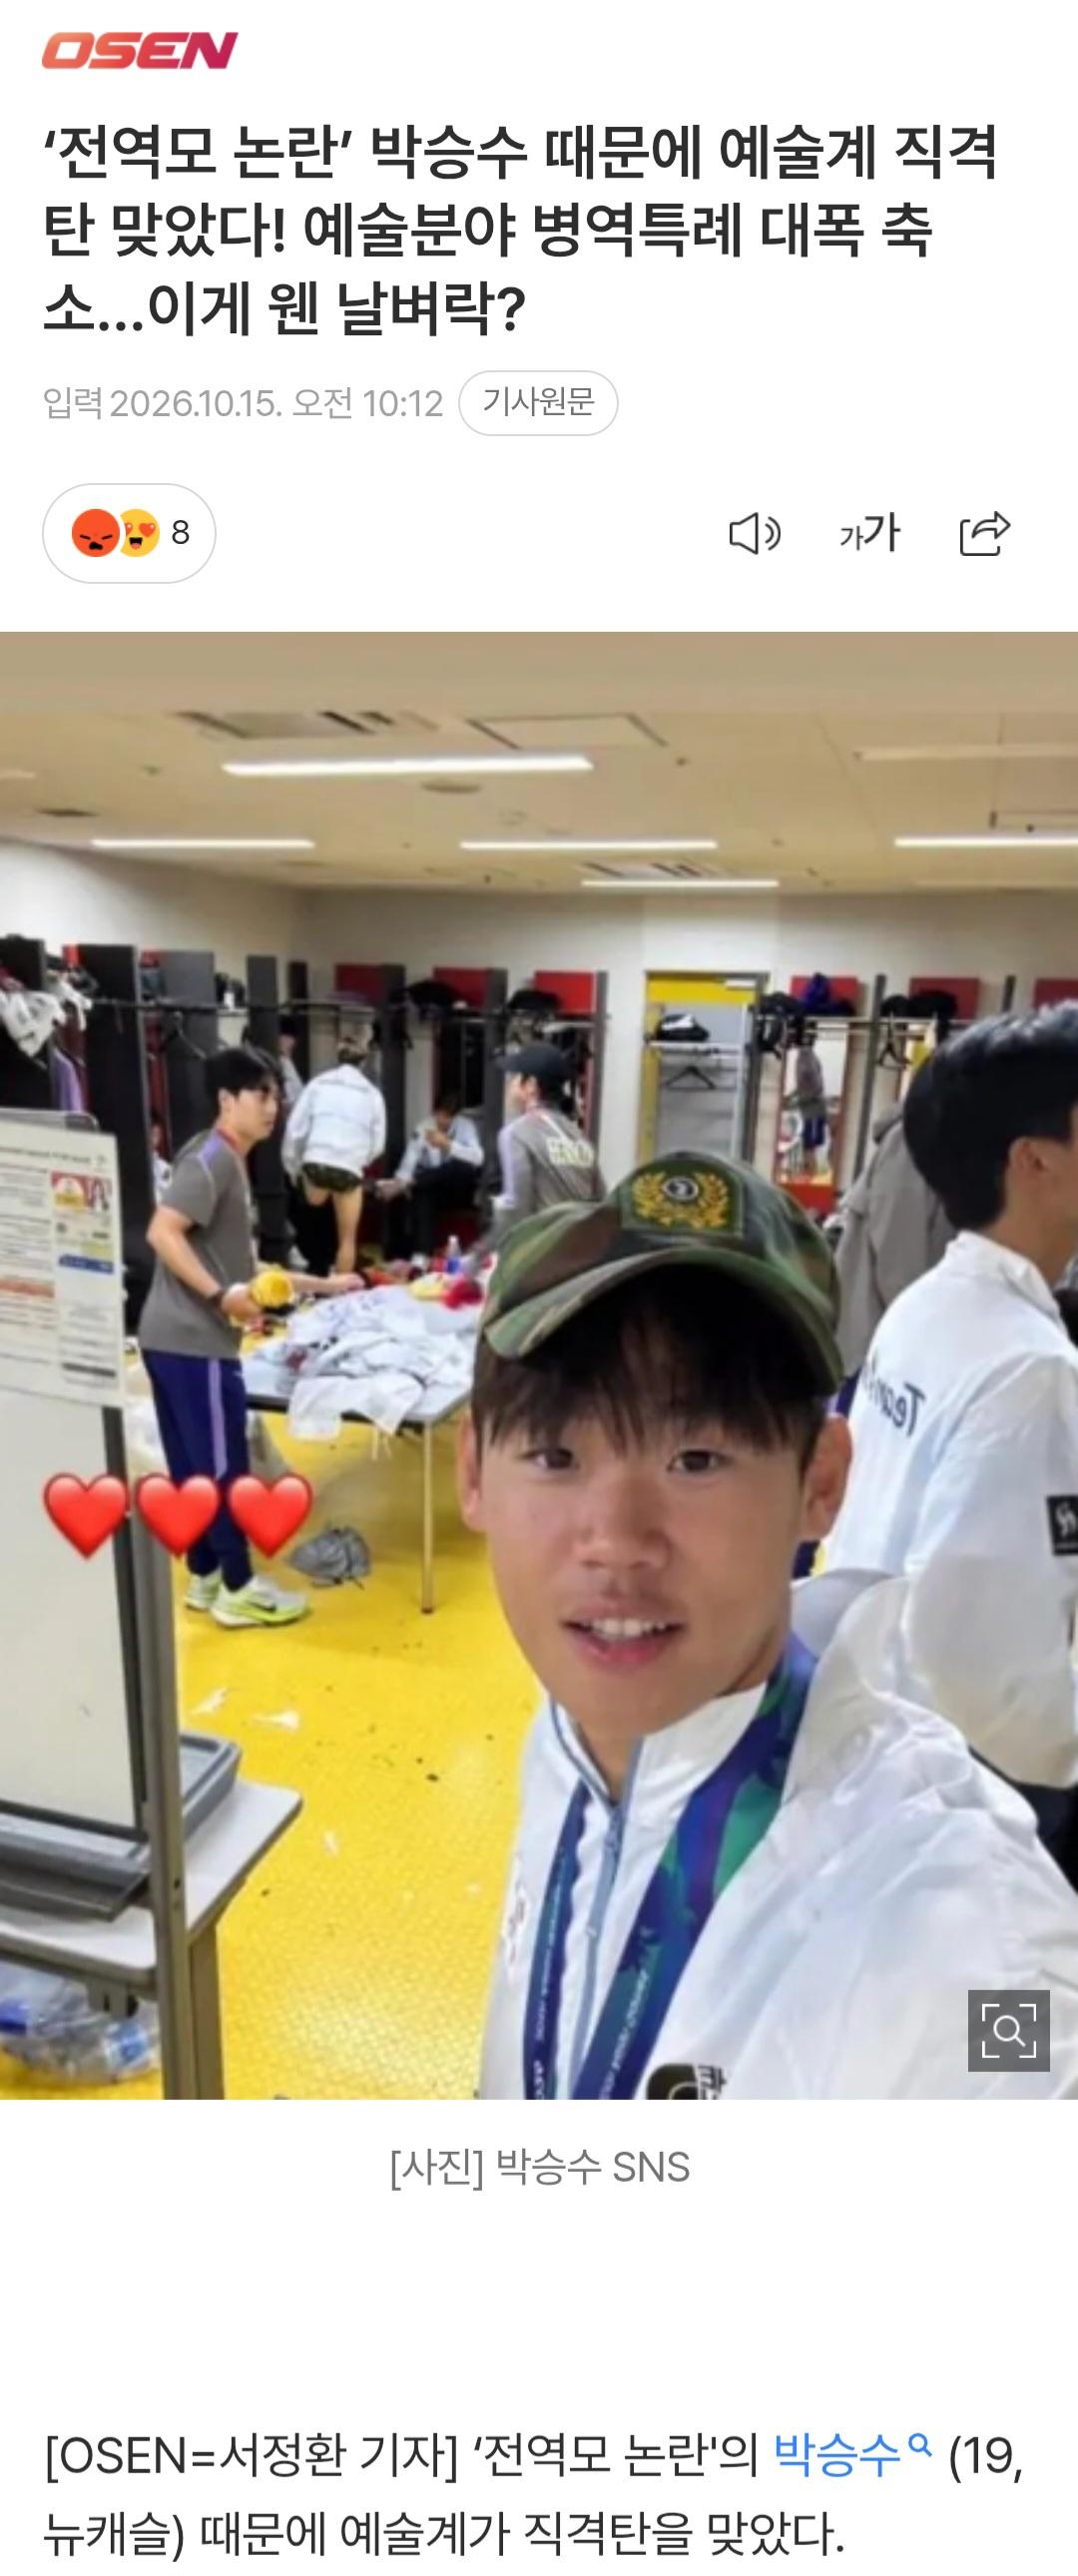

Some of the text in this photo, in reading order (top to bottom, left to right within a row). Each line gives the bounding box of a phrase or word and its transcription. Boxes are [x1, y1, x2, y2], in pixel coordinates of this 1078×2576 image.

[42, 32, 239, 69] OSEN
[44, 125, 995, 181] ‘전역모 논란’ 박승수 때문에 예술계 직격
[45, 202, 933, 258] 탄 맞았다! 예술분야 병역특례 대폭 축
[268, 280, 318, 336] 웬
[338, 280, 526, 337] 날벼락?
[43, 386, 443, 420] 입력 2026.10.15. 오전 10:12
[483, 385, 596, 417] 기사원문
[171, 519, 191, 545] 8
[390, 2147, 691, 2192] [사진] 박승수 SNS
[46, 2431, 1022, 2484] [OSEN=서정환 기자] ‘전역모 논란'의 박승수 (19,
[43, 2510, 844, 2563] 뉴캐슬) 때문에 예술계가 직격탄을 맞았다.
